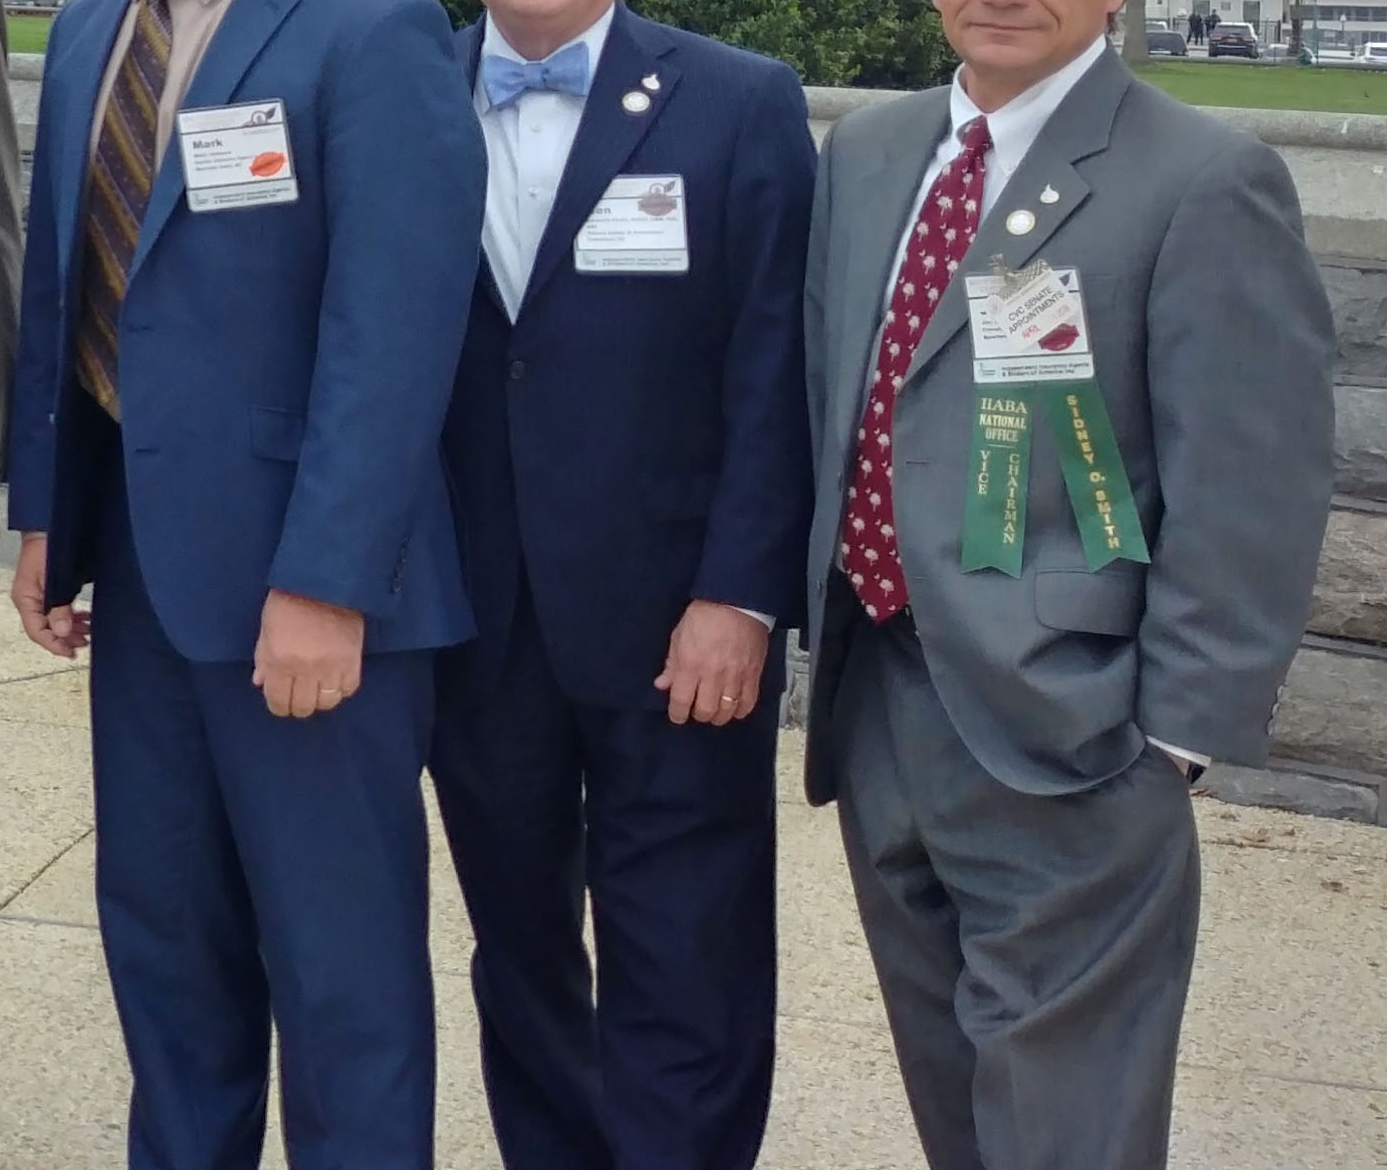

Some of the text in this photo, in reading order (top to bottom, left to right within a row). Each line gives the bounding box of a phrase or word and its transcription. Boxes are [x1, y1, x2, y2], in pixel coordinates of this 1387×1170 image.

[192, 138, 224, 150] Mark
[1008, 286, 1053, 321] CVC SENATE
[1009, 290, 1065, 334] APPOINTMENTS
[980, 397, 1028, 414] IIABA
[979, 413, 1027, 429] NATIONAL
[985, 428, 1019, 442] OFFICE
[1067, 395, 1095, 465] SIDNEY
[1095, 489, 1120, 549] SMITH
[978, 450, 1020, 544] VICE CHAIRMAN
